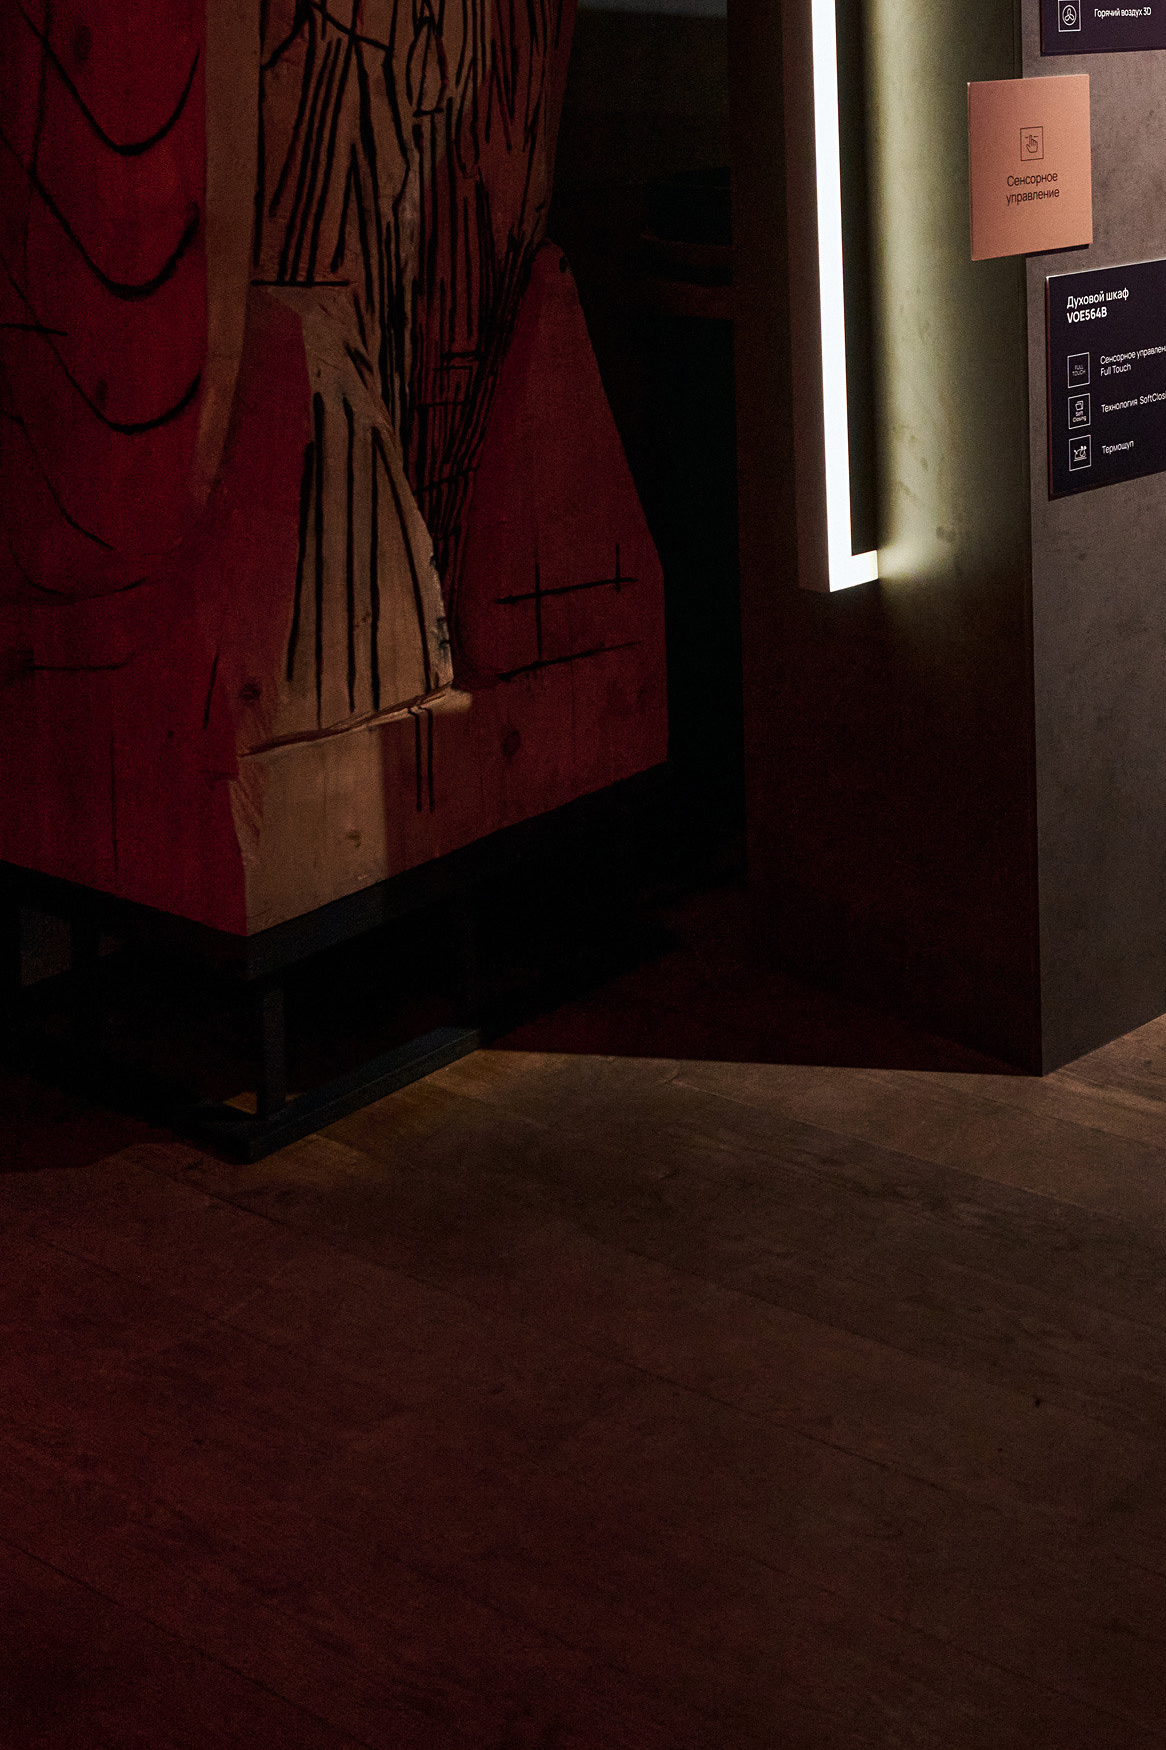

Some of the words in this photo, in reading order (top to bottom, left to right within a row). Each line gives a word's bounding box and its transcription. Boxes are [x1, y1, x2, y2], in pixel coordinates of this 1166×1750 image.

[1094, 8, 1120, 19] Горячий
[1121, 9, 1142, 18] воздух
[1143, 7, 1152, 16] 3D
[1006, 172, 1058, 187] Сенсорное
[1006, 188, 1060, 206] управление
[1066, 290, 1105, 309] Духовой
[1106, 287, 1130, 301] шкаф
[1066, 307, 1108, 323] VOE564B
[1100, 353, 1135, 365] Сенсорное
[1100, 366, 1111, 376] Full
[1112, 363, 1132, 374] Touch
[1101, 399, 1138, 413] Технология
[1102, 440, 1135, 454] Термощуп
